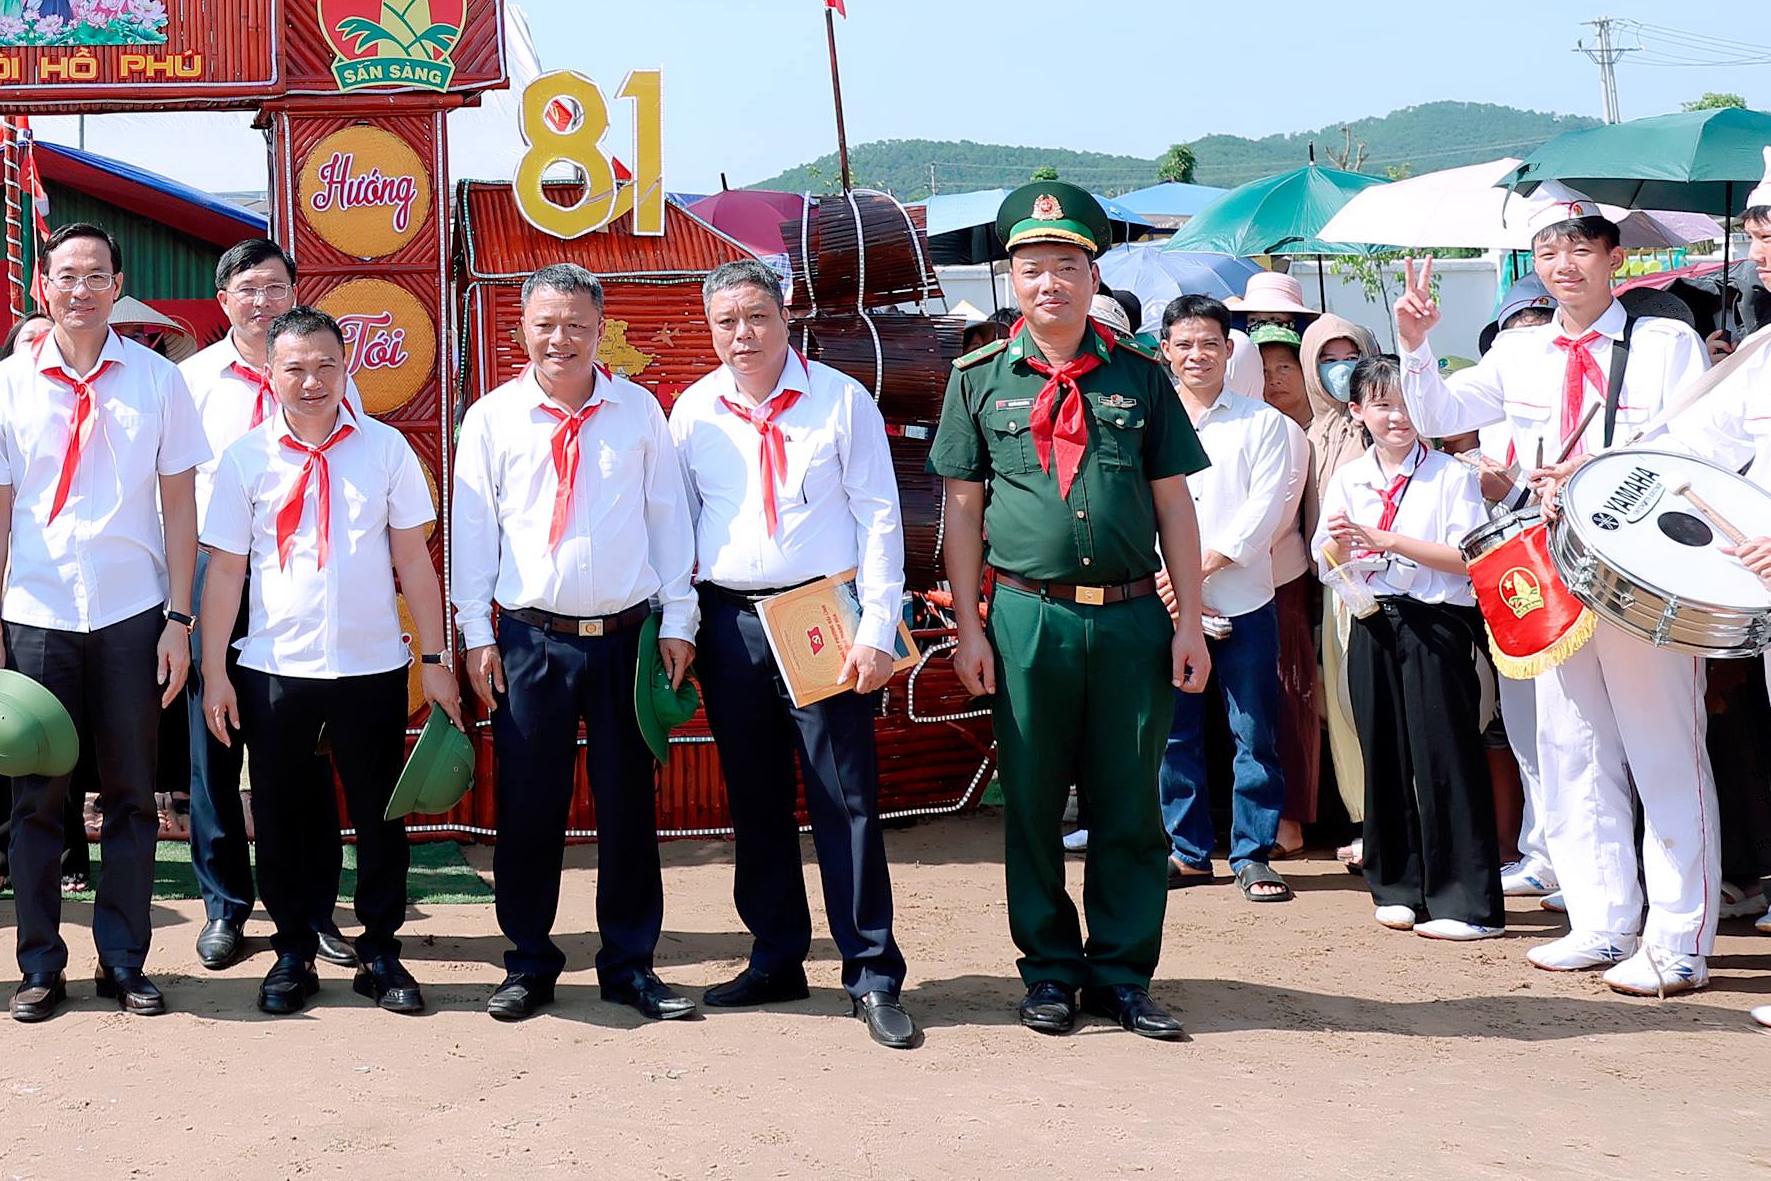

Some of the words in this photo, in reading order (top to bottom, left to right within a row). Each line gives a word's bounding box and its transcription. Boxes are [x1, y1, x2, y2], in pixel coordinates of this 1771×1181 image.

[40, 46, 98, 80] HỒ
[120, 49, 202, 77] PHÚ
[389, 62, 442, 84] SÀNG
[513, 65, 665, 240] 81
[311, 151, 418, 233] Hướng
[337, 311, 409, 375] Tới
[1603, 466, 1660, 515] YAMAHA
